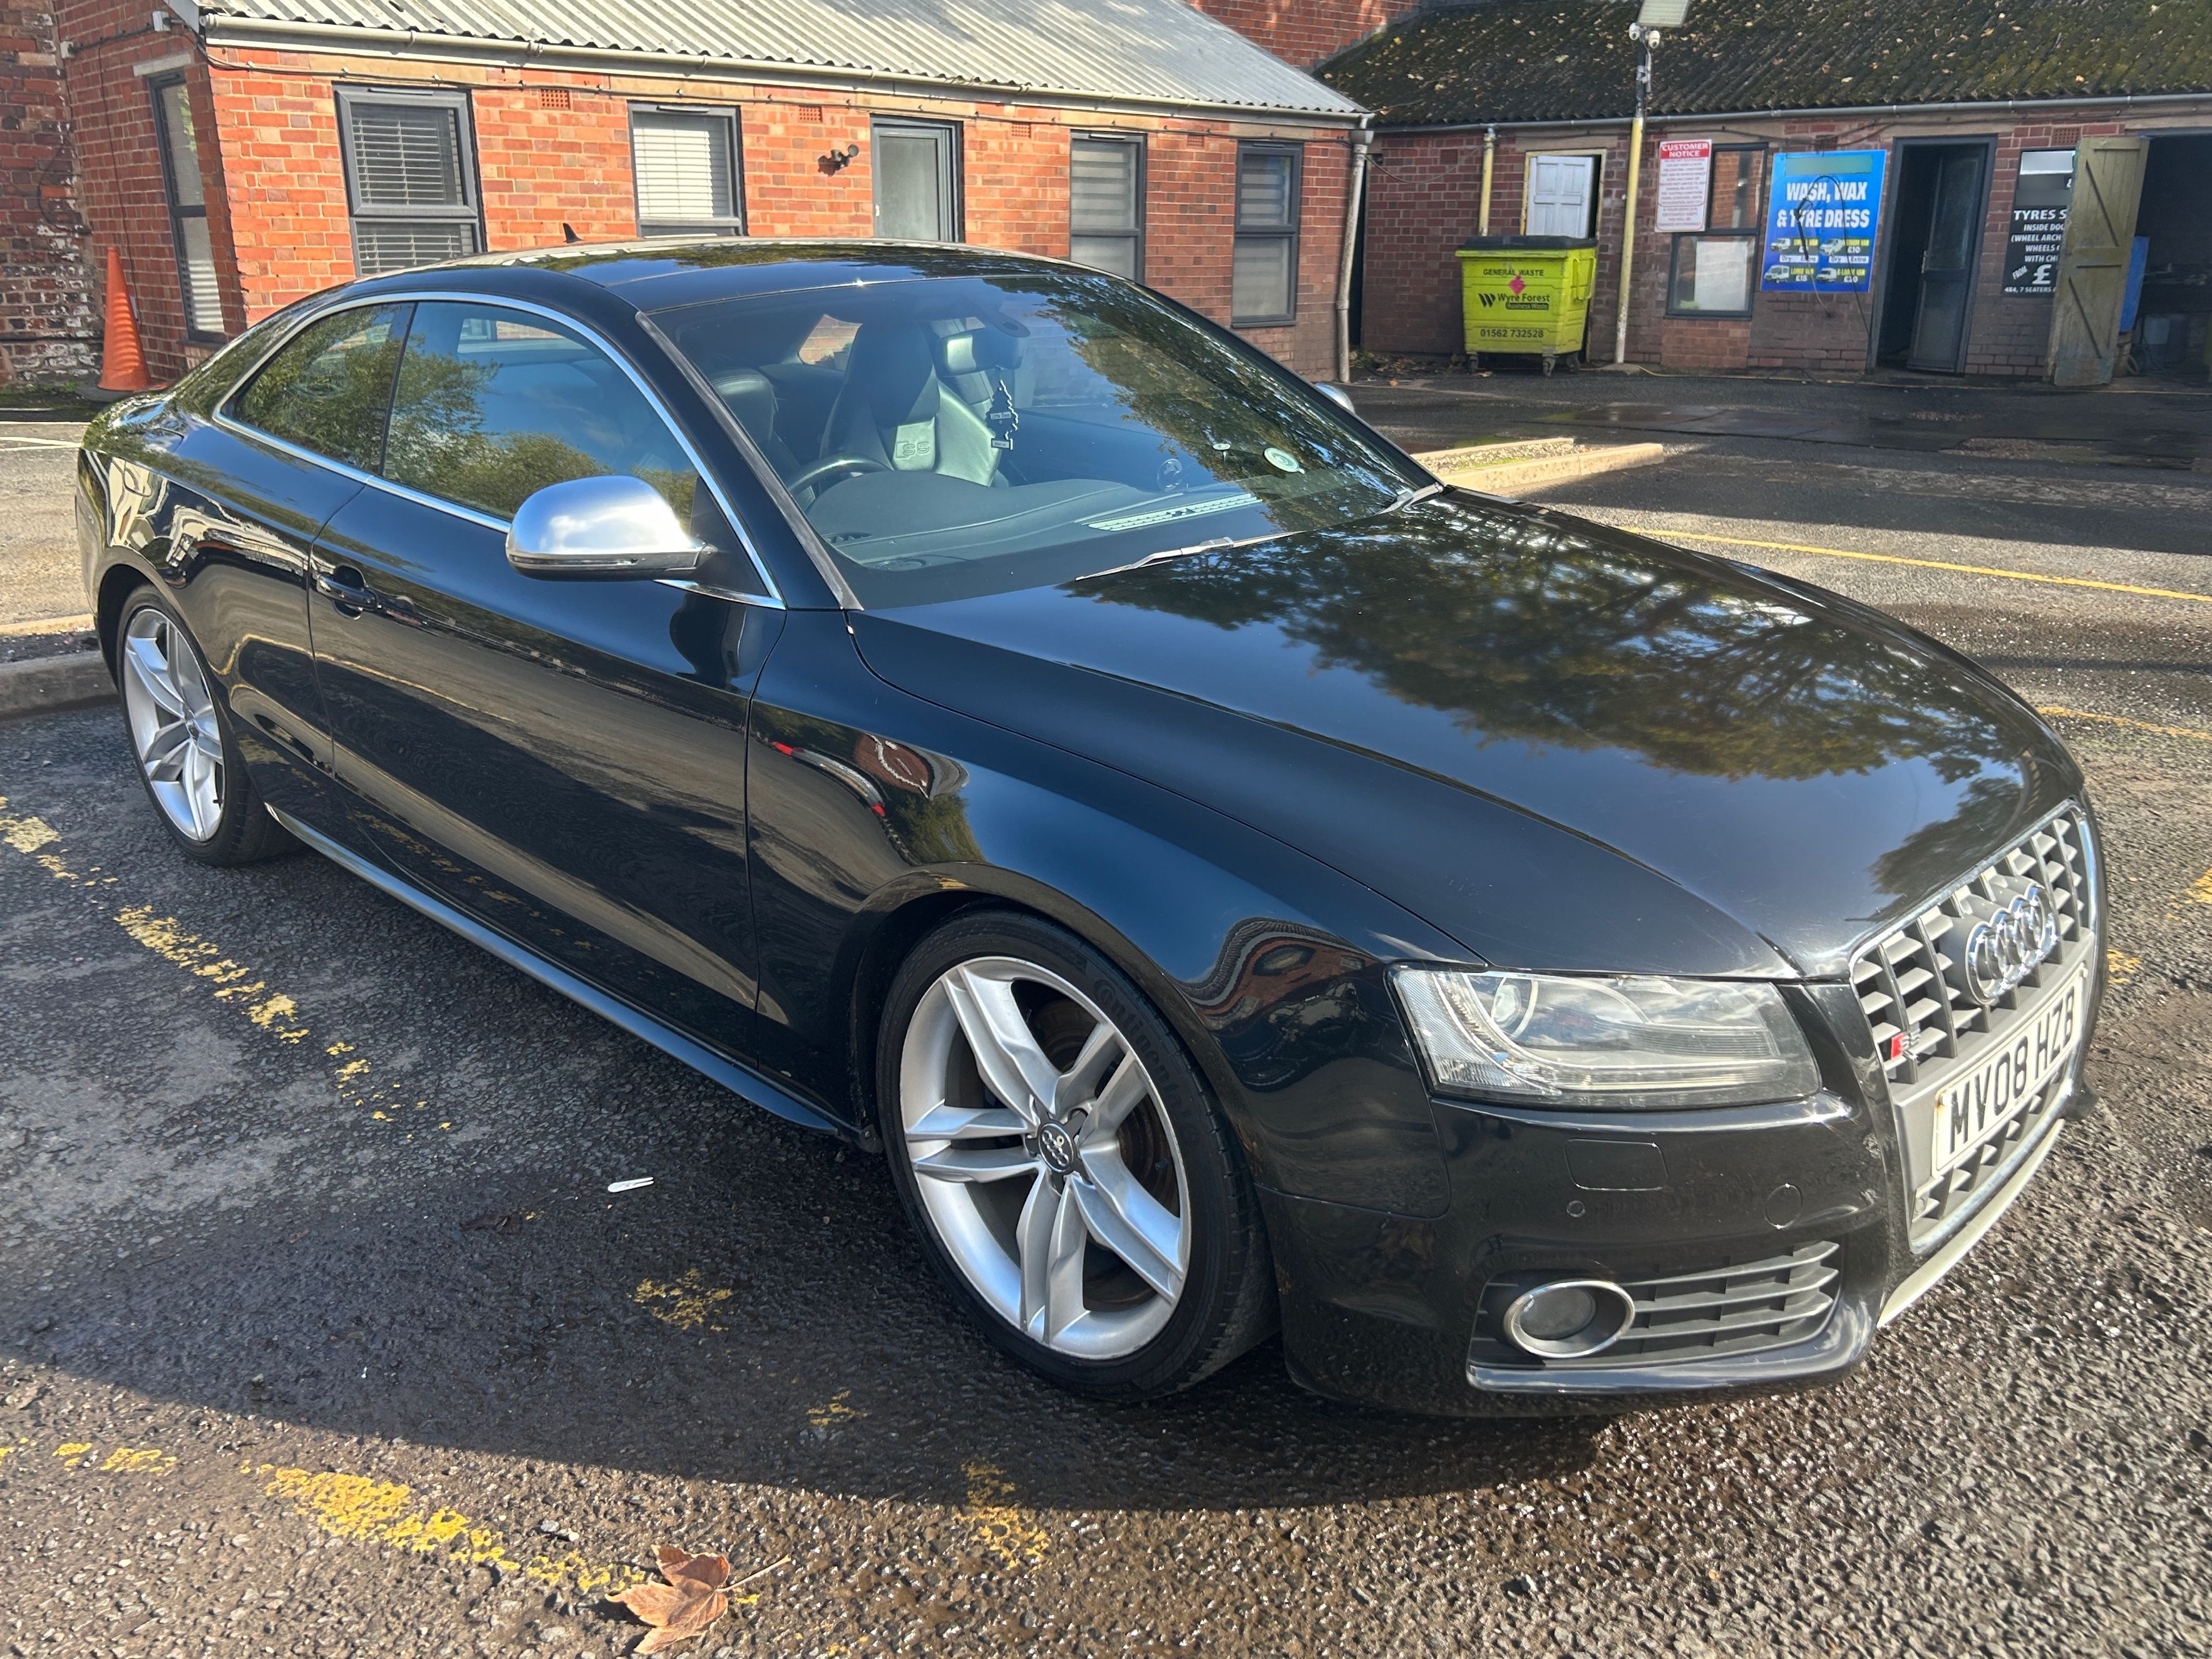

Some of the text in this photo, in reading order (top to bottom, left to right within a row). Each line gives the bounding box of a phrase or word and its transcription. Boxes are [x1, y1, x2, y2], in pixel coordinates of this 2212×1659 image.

[1662, 143, 1709, 152] CUSTOMER
[1786, 182, 1868, 203] WASH, WAX
[1776, 209, 1870, 228] & TYRE DRESS
[2014, 210, 2056, 220] TYRES
[2011, 234, 2039, 242] (WHEEL
[2012, 265, 2028, 280] FROM
[2032, 264, 2052, 284] £
[1497, 293, 1550, 303] Wyre Forest
[1480, 329, 1544, 338] 01562 732528
[903, 441, 930, 456] S5
[2034, 985, 2075, 1081] HZB
